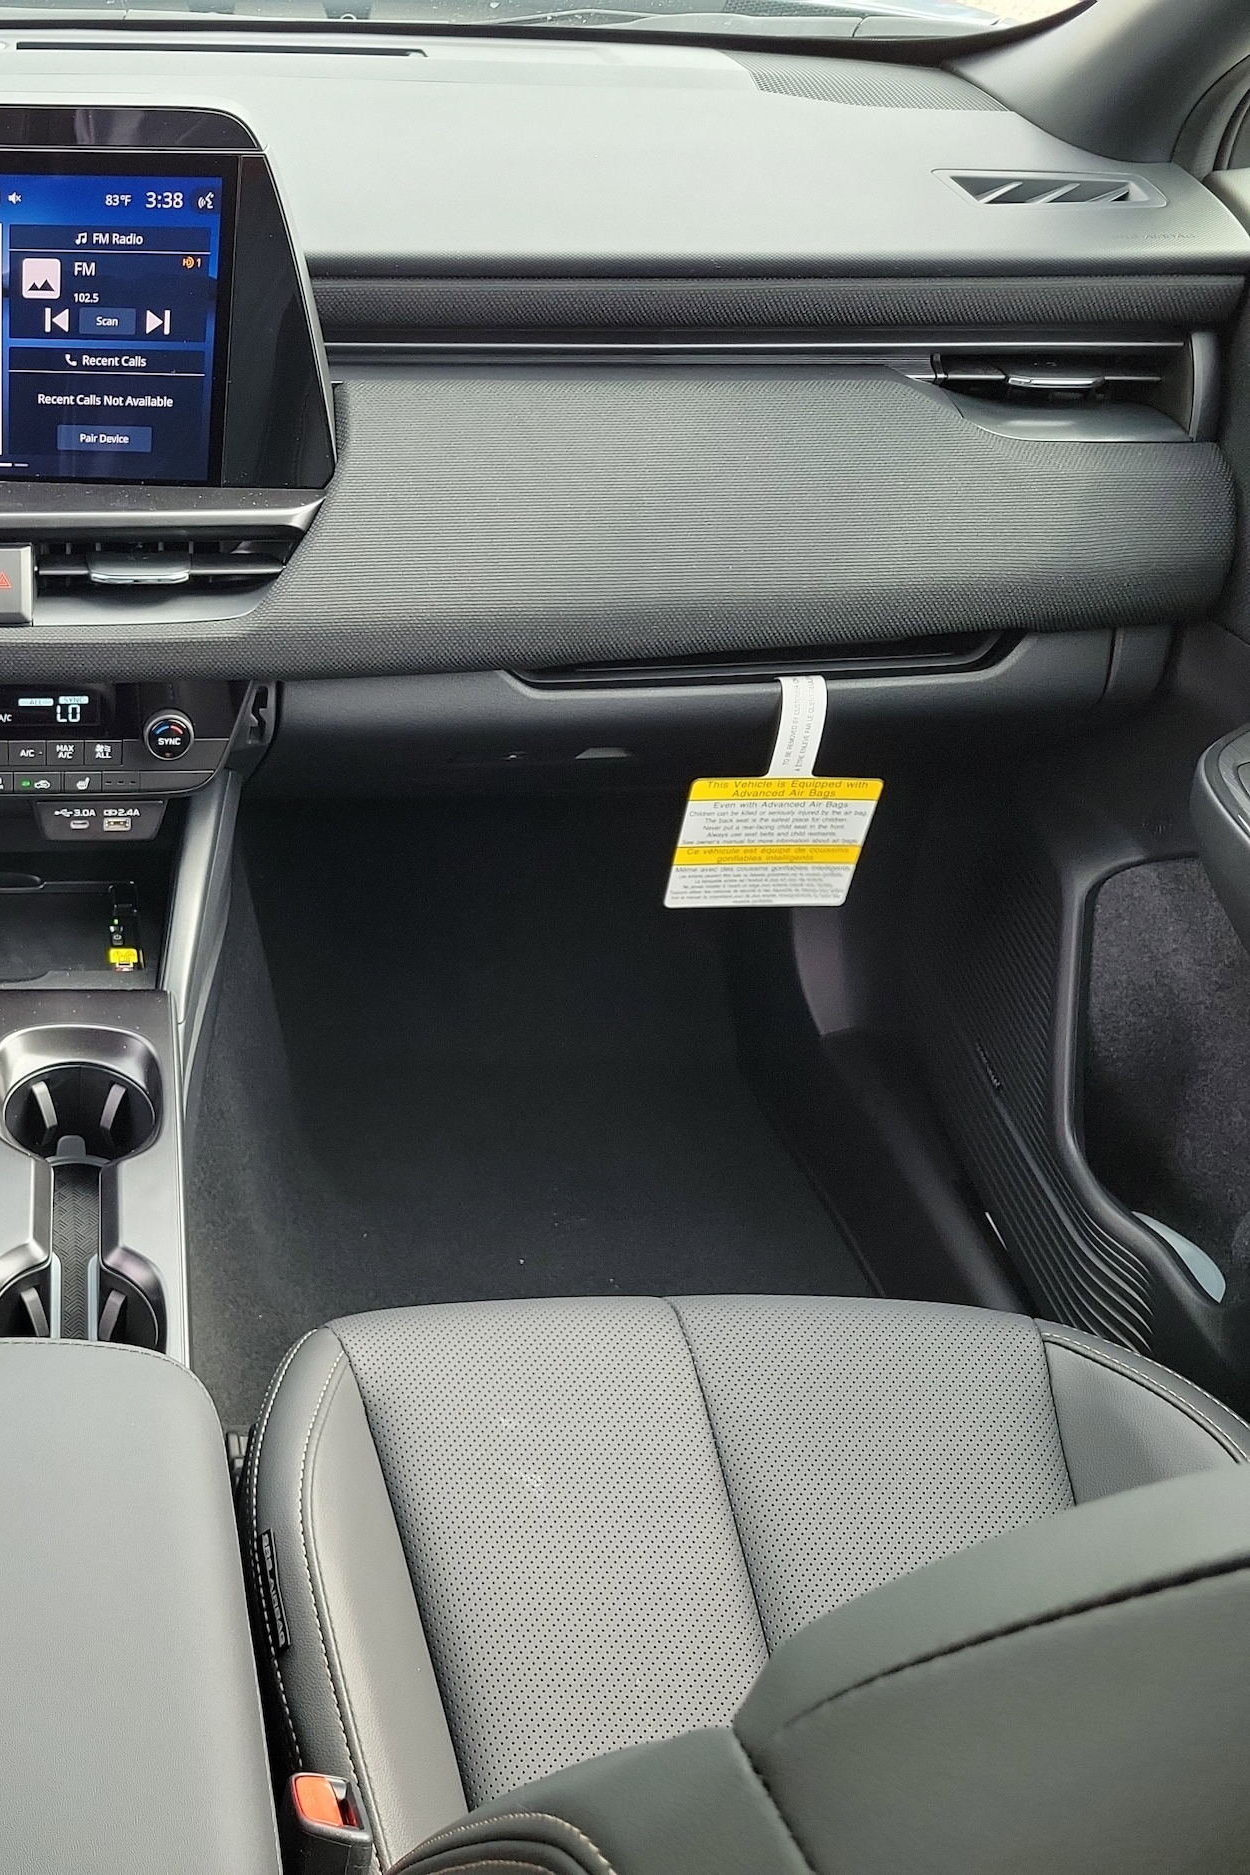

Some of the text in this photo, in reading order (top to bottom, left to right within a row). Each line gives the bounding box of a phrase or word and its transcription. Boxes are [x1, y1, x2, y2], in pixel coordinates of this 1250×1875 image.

[105, 194, 132, 206] 83°F
[145, 192, 183, 208] 3:38
[93, 233, 143, 245] FM Radio
[74, 262, 95, 276] FM
[74, 293, 99, 303] 102.5
[96, 317, 118, 326] Scan
[82, 355, 147, 367] Recent Calls
[38, 394, 173, 408] Recent Calls Not Available
[80, 434, 129, 444] Pair Device
[56, 704, 80, 722] LO
[158, 738, 181, 746] SYNC
[56, 744, 74, 752] MAX
[707, 781, 728, 789] This
[777, 780, 786, 788] is
[791, 780, 842, 789] Equipped
[846, 781, 868, 789] with
[732, 789, 836, 799] Advanced Air Bags
